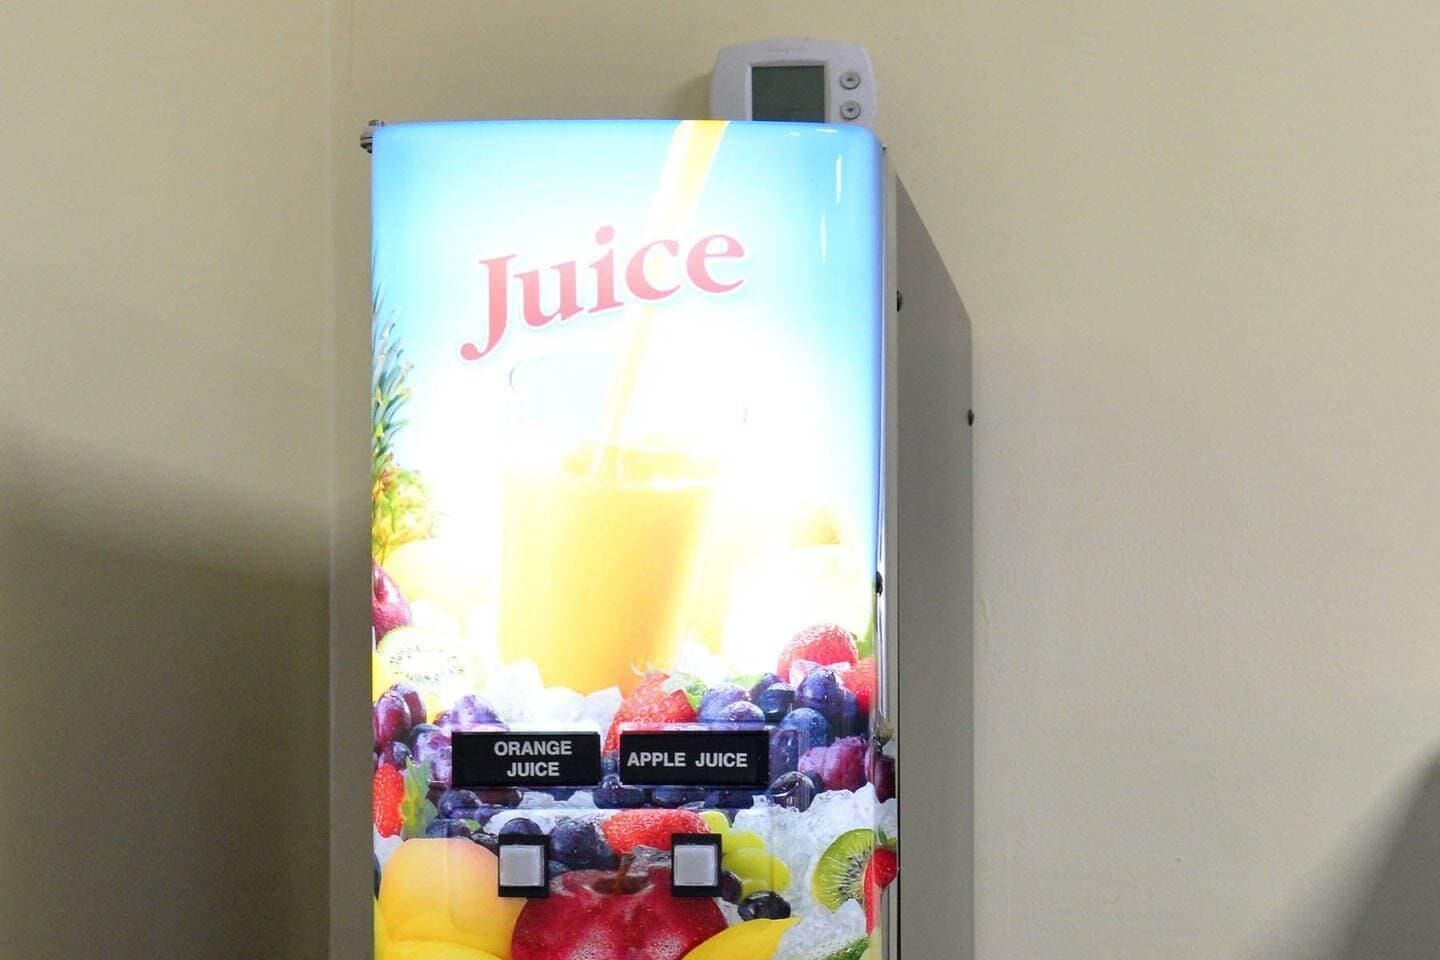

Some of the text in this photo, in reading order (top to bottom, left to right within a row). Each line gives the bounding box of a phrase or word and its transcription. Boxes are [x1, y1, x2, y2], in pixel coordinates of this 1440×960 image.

[460, 225, 745, 361] Juice
[494, 741, 572, 756] ORANGE
[627, 752, 748, 768] APPLE JUICE
[507, 762, 560, 777] JUICE
